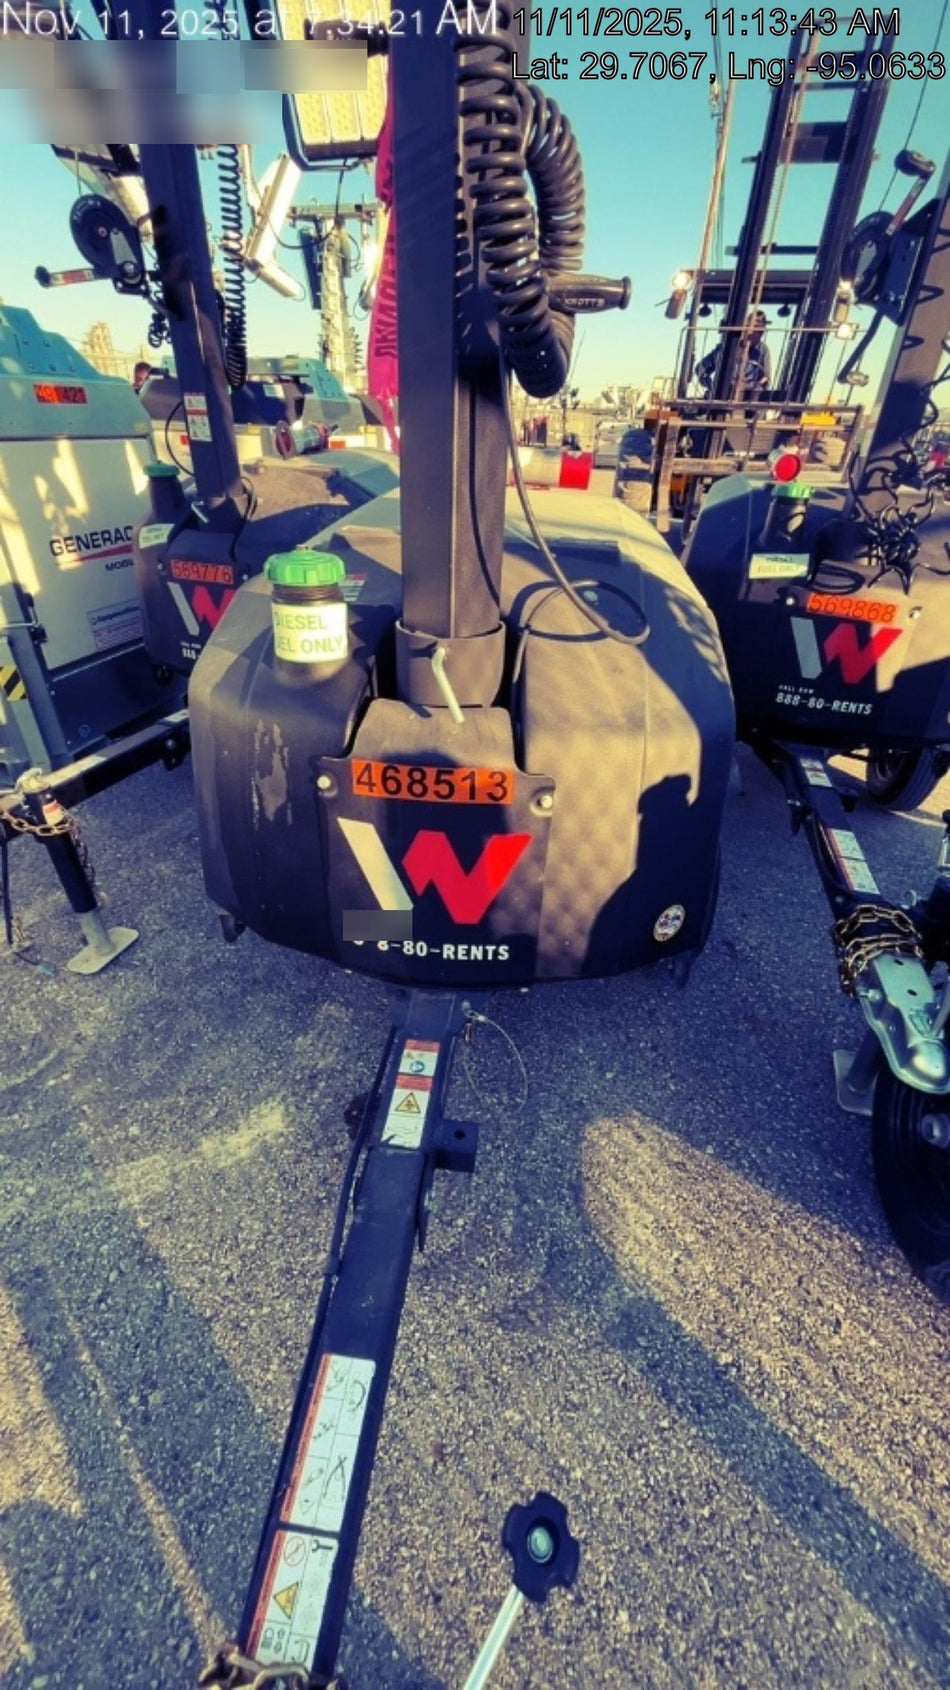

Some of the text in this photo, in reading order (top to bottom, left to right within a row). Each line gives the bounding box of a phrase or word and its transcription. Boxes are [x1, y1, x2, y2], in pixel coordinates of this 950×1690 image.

[49, 525, 134, 557] GENERAC
[809, 593, 897, 623] 569868
[300, 635, 344, 654] ONLY
[775, 692, 873, 715] 888-80-RENTS
[355, 762, 510, 803] 468513
